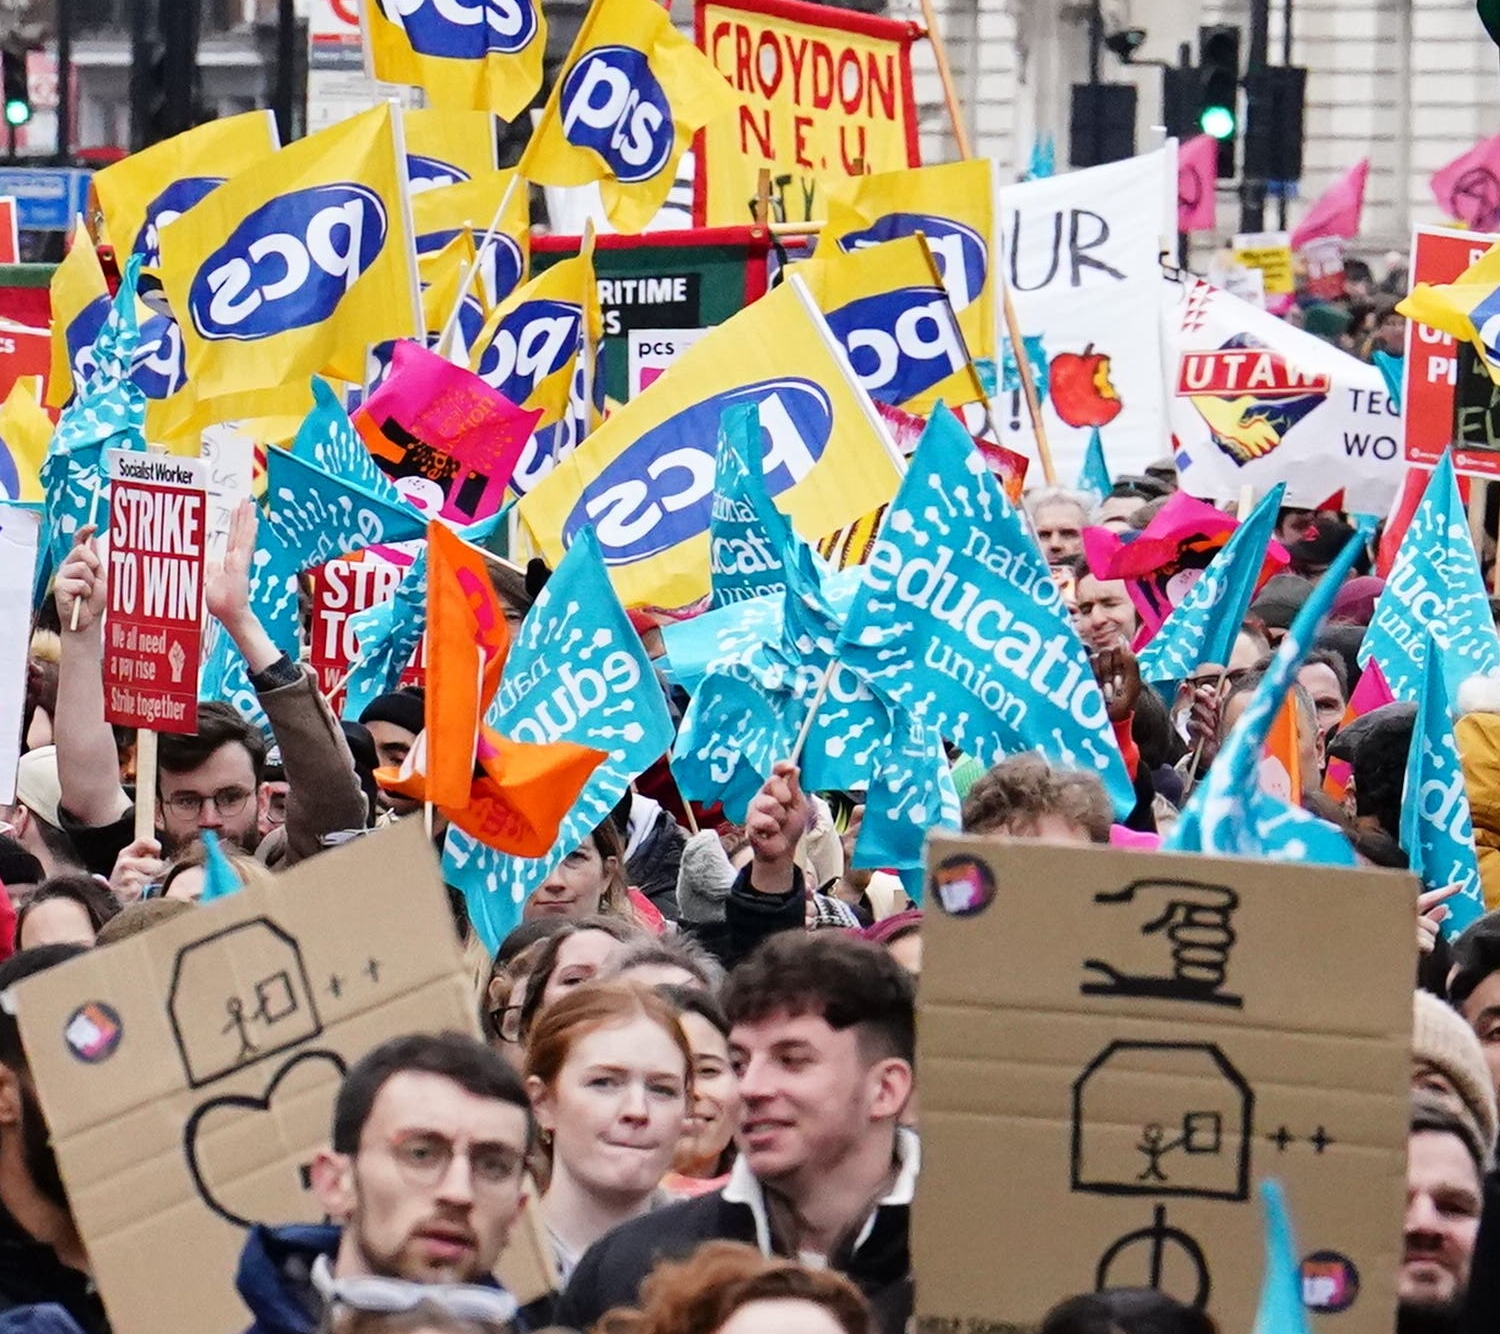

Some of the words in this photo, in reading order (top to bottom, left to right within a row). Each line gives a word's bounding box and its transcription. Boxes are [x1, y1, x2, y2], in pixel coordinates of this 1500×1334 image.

[712, 21, 896, 121] CROYDON
[564, 60, 663, 181] pcs
[638, 341, 675, 358] pcs
[118, 458, 154, 483] Socialist
[153, 463, 194, 485] Worker
[111, 486, 201, 558] STRIKE
[110, 550, 137, 616] TO
[141, 556, 199, 622] WIN
[961, 525, 1070, 629] natio
[110, 623, 126, 649] We
[125, 625, 137, 652] all
[138, 628, 167, 656] need
[117, 658, 134, 683] pay
[134, 658, 157, 681] rise
[862, 535, 1112, 737] educatio
[110, 685, 136, 713] Strike
[136, 691, 187, 723] together
[925, 637, 1029, 731] union
